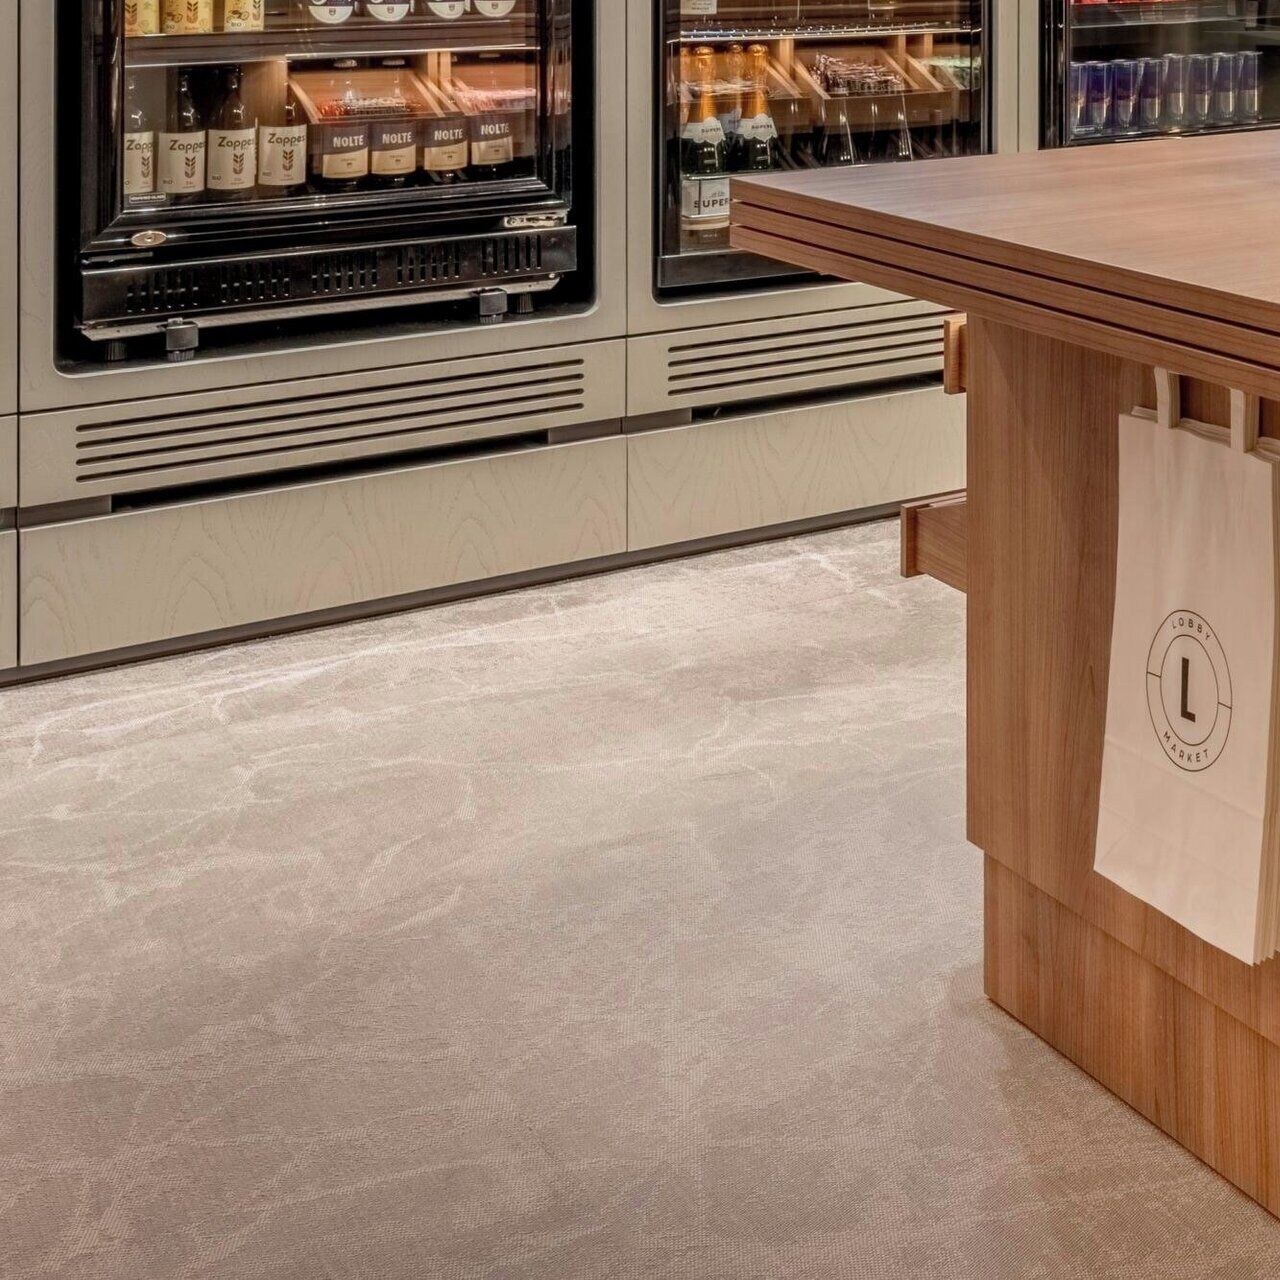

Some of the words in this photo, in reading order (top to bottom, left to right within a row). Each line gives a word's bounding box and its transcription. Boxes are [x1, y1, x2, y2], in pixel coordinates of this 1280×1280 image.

[433, 128, 464, 141] NOLTE
[480, 122, 510, 136] NOLTE
[332, 134, 364, 148] NOLTE
[381, 131, 412, 144] NOLTE
[1172, 617, 1212, 641] LOBBY
[1180, 656, 1196, 723] L
[1163, 730, 1209, 763] MARKET
